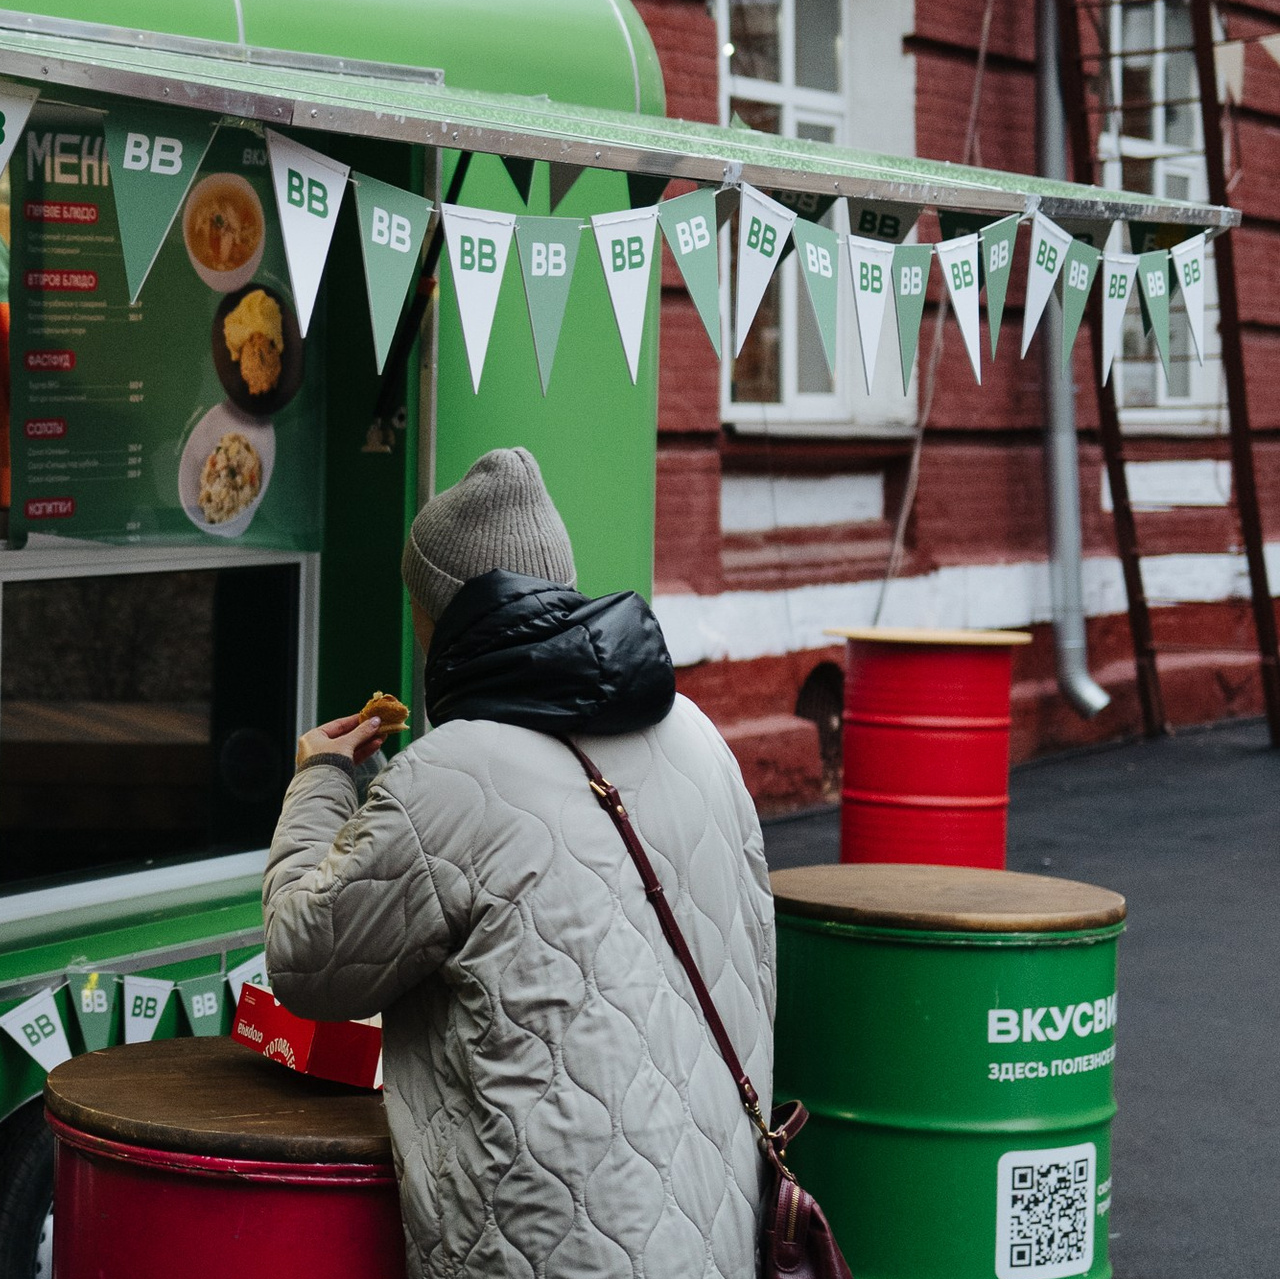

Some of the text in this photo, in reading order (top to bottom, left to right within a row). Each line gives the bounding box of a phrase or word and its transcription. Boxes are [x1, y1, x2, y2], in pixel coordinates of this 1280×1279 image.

[123, 132, 183, 175] ВВ
[287, 167, 329, 219] ВВ
[372, 206, 411, 253] ВВ
[675, 215, 711, 255] ВВ
[747, 216, 777, 258] ВВ
[460, 235, 497, 273] ВВ
[531, 242, 566, 276] ВВ
[611, 236, 645, 272] ВВ
[81, 989, 108, 1014] ВВ
[131, 995, 158, 1019] ВВ
[191, 992, 218, 1018] ВВ
[22, 1013, 57, 1047] ВВ
[988, 1061, 1049, 1082] ЗДЕСЬ
